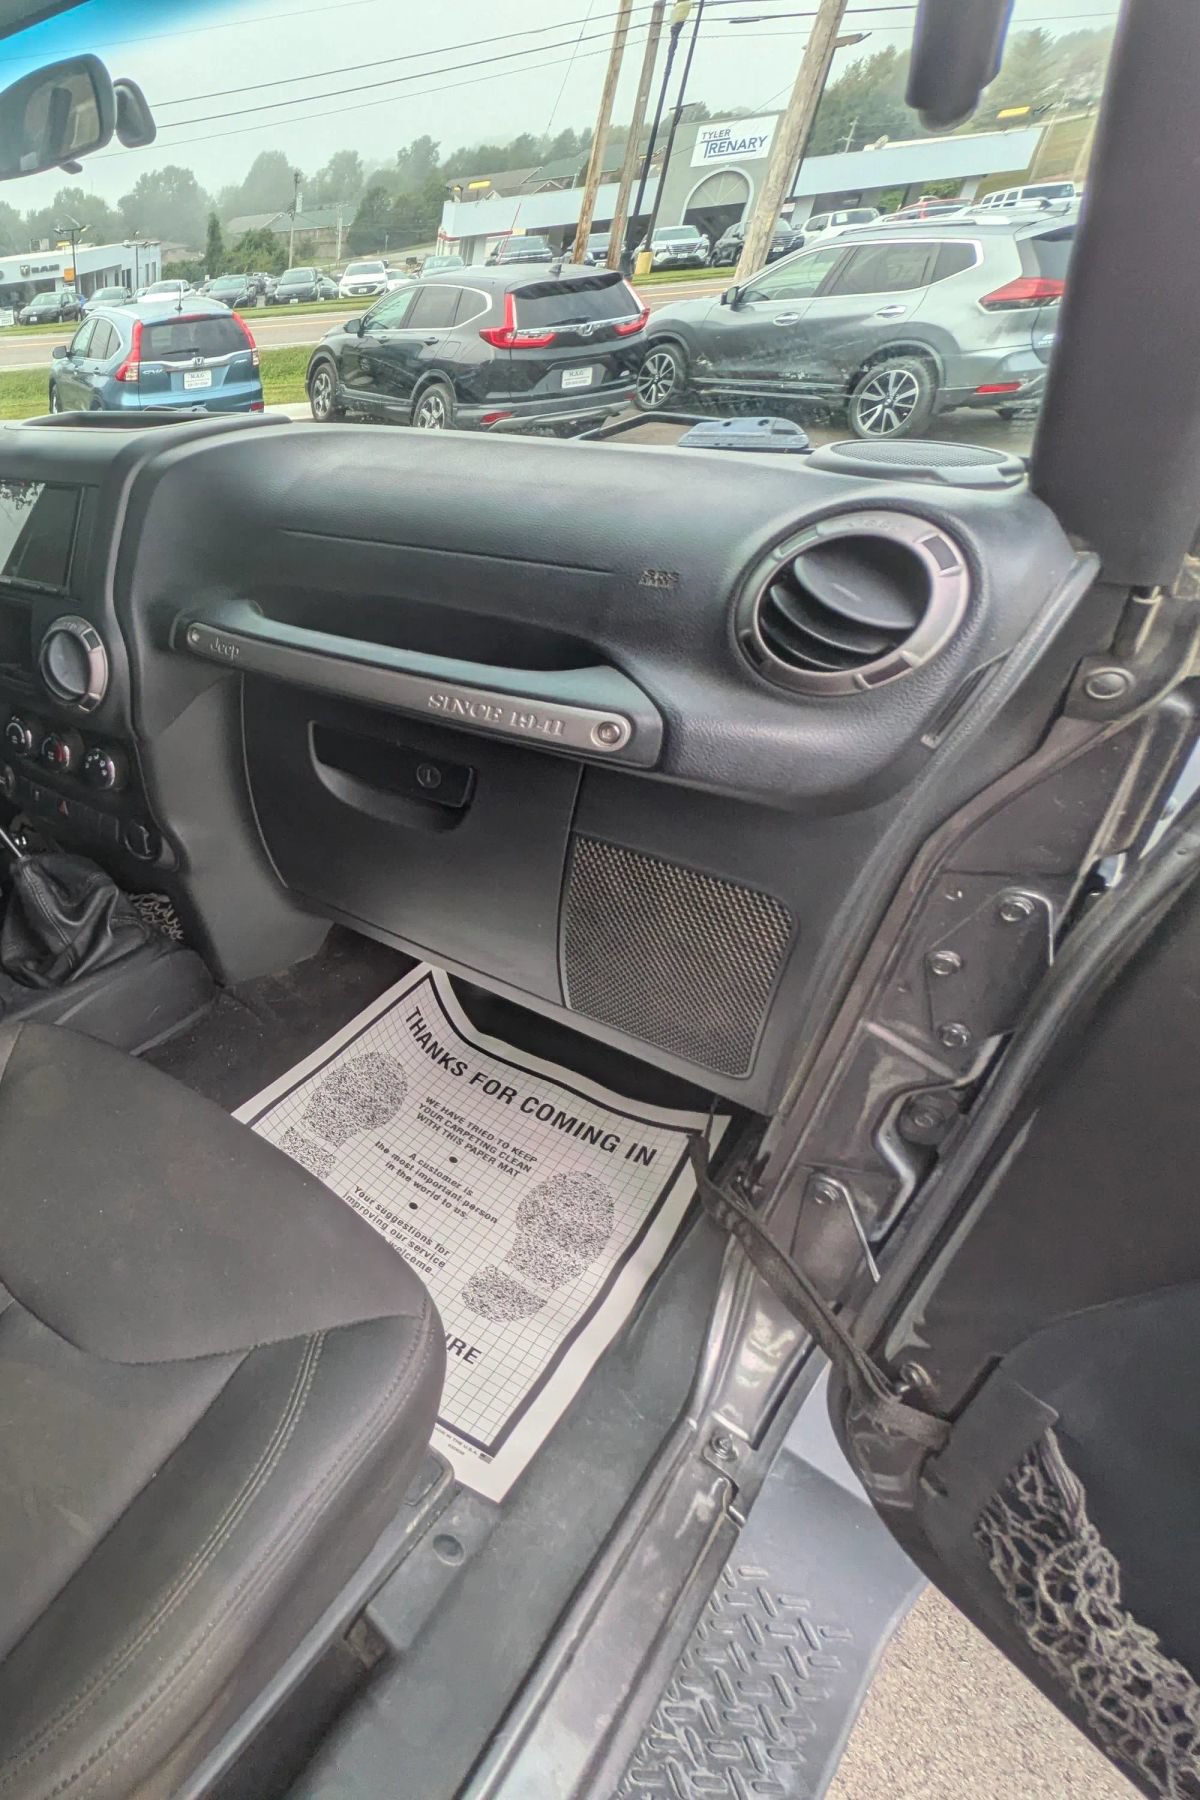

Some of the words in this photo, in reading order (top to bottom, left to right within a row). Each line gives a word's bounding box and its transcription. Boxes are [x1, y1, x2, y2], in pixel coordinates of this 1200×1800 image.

[701, 135, 768, 159] TRENARY
[702, 128, 731, 140] TYLER
[210, 637, 240, 661] Jeep
[428, 694, 502, 722] SINCE
[509, 711, 568, 737] 1941
[405, 1006, 469, 1078] THANKS
[469, 1071, 518, 1105] FOR
[520, 1096, 621, 1153] COMING
[624, 1143, 657, 1166] IN
[416, 1112, 441, 1133] WITH
[441, 1128, 464, 1146] THIS
[464, 1142, 497, 1166] PAPER
[497, 1161, 521, 1178] MAT
[418, 1103, 444, 1123] YOUR
[443, 1120, 497, 1155] CARPETING
[498, 1151, 532, 1173] CLEAN
[425, 1096, 441, 1109] WE
[441, 1106, 466, 1125] HAVE
[467, 1121, 495, 1141] TRIED
[496, 1138, 510, 1150] TO
[511, 1146, 538, 1164] KEEP
[375, 1140, 390, 1154] the
[391, 1152, 414, 1172] most
[414, 1167, 462, 1203] important
[462, 1198, 499, 1224] person
[385, 1161, 395, 1172] in
[396, 1168, 412, 1183] the
[412, 1180, 441, 1201] world
[441, 1196, 452, 1209] to
[453, 1206, 468, 1220] us.
[408, 1152, 418, 1161] A
[417, 1158, 463, 1189] customer
[463, 1183, 474, 1197] is
[354, 1186, 376, 1204] Your
[375, 1203, 433, 1246] suggestions
[434, 1243, 450, 1257] for
[390, 1228, 408, 1243] our
[408, 1241, 446, 1268] service
